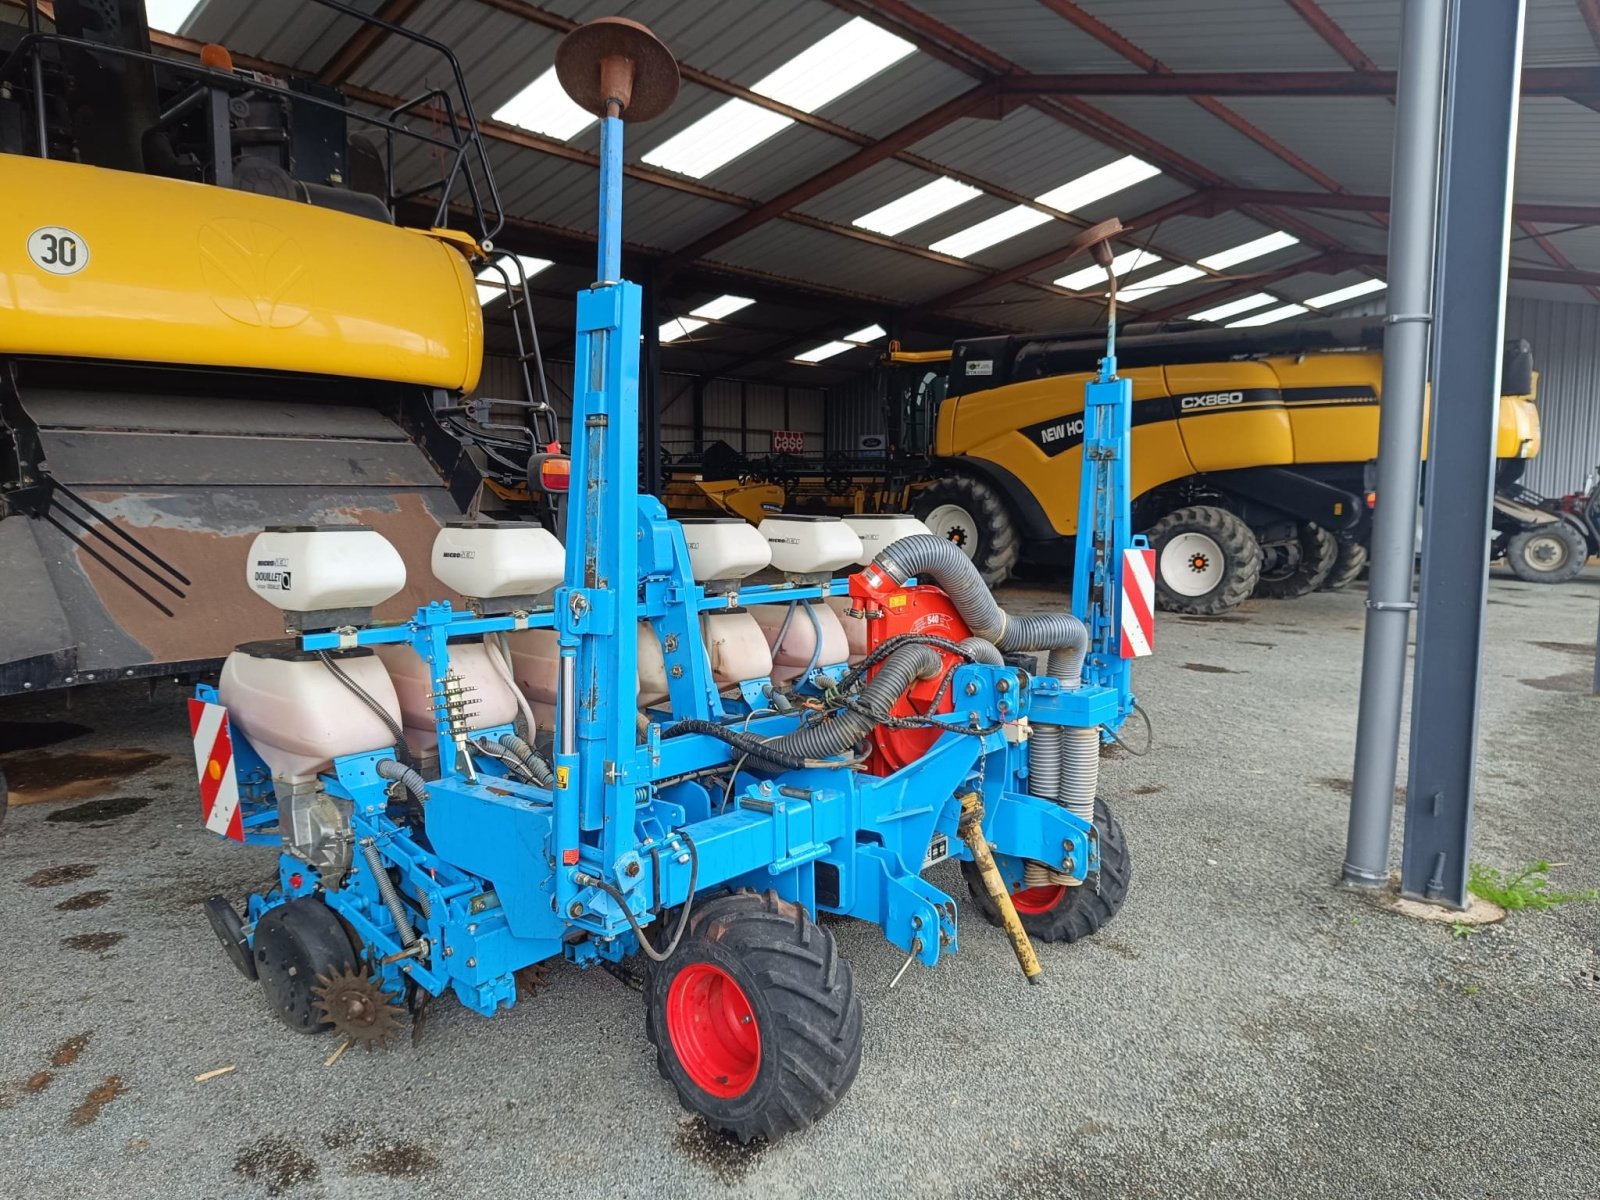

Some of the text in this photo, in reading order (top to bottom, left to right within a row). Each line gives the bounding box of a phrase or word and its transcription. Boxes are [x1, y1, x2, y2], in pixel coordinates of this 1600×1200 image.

[40, 233, 76, 267] 30
[1181, 392, 1243, 408] CX860
[1041, 424, 1065, 444] NEW
[255, 571, 282, 582] DOUILLET
[927, 614, 940, 625] 540
